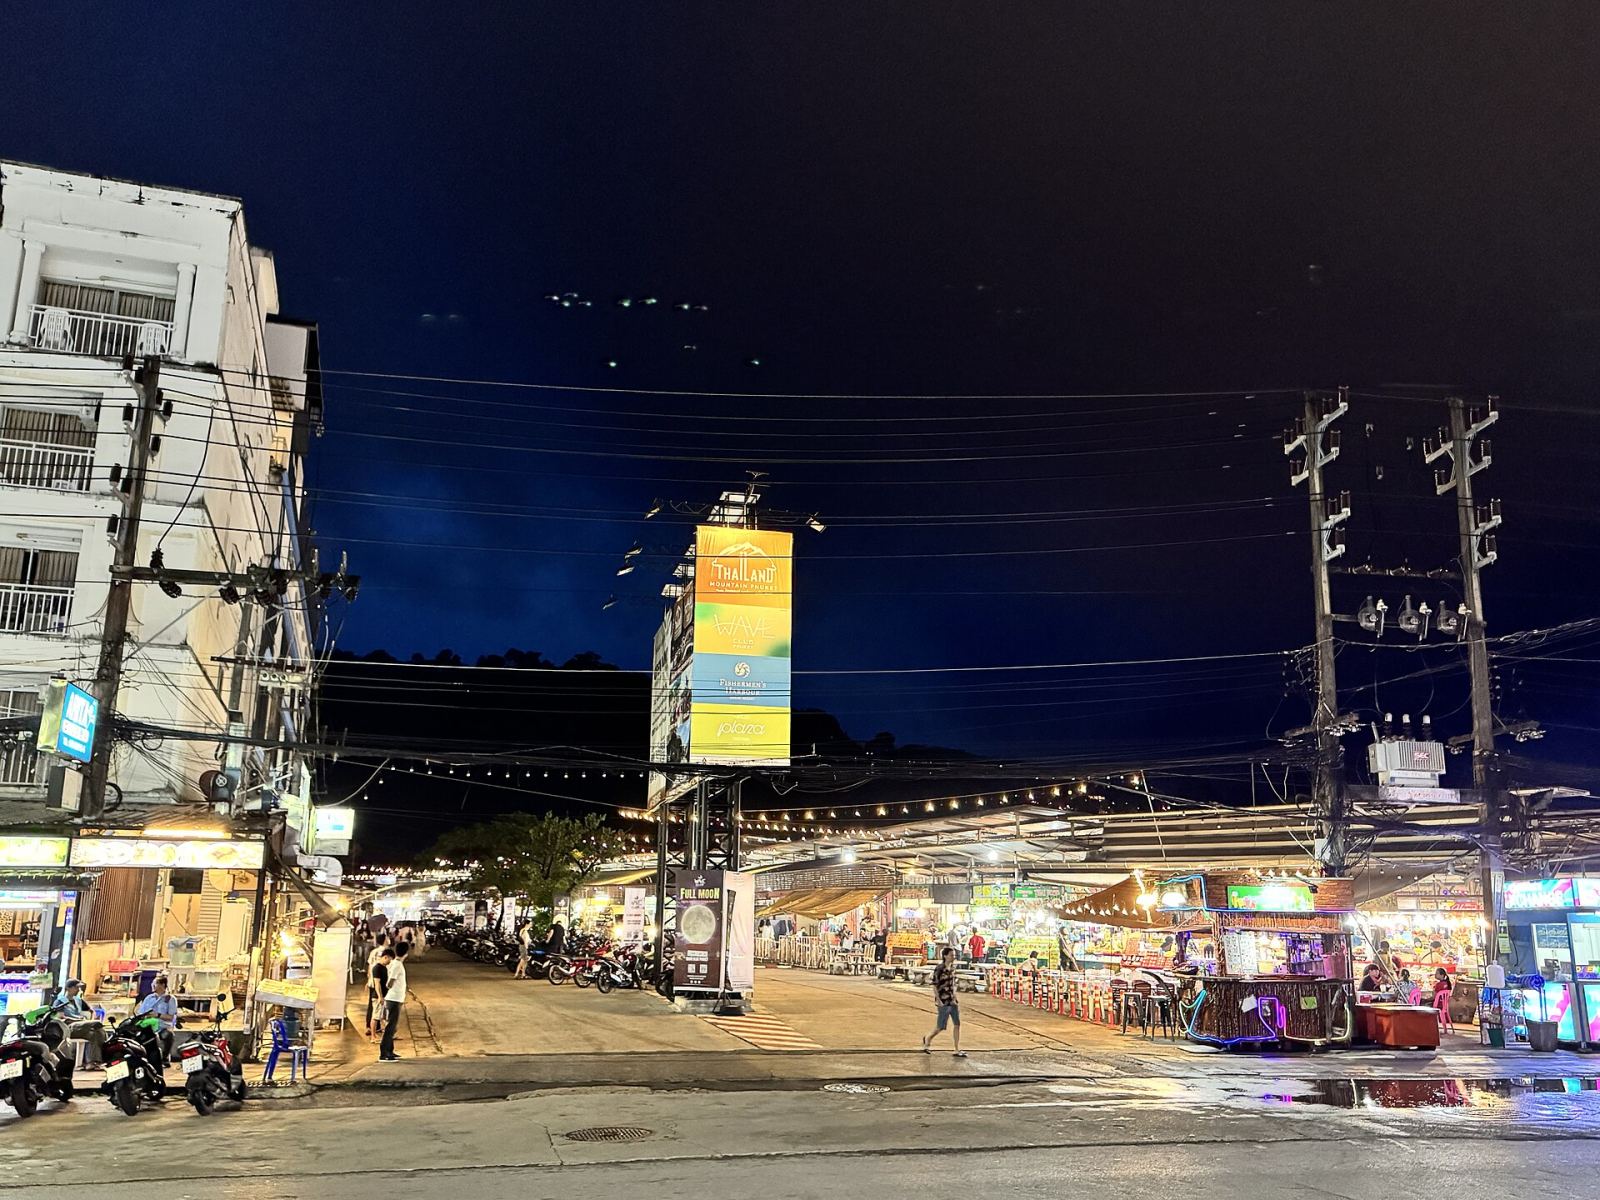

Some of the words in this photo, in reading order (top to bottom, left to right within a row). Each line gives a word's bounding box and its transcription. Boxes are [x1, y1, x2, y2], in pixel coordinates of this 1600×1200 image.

[713, 551, 776, 583] THAILAND
[709, 581, 748, 589] MOUNTAIN
[712, 613, 776, 639] WAVE
[717, 721, 766, 737] plaza
[680, 887, 696, 899] FULL
[698, 887, 720, 900] MOON
